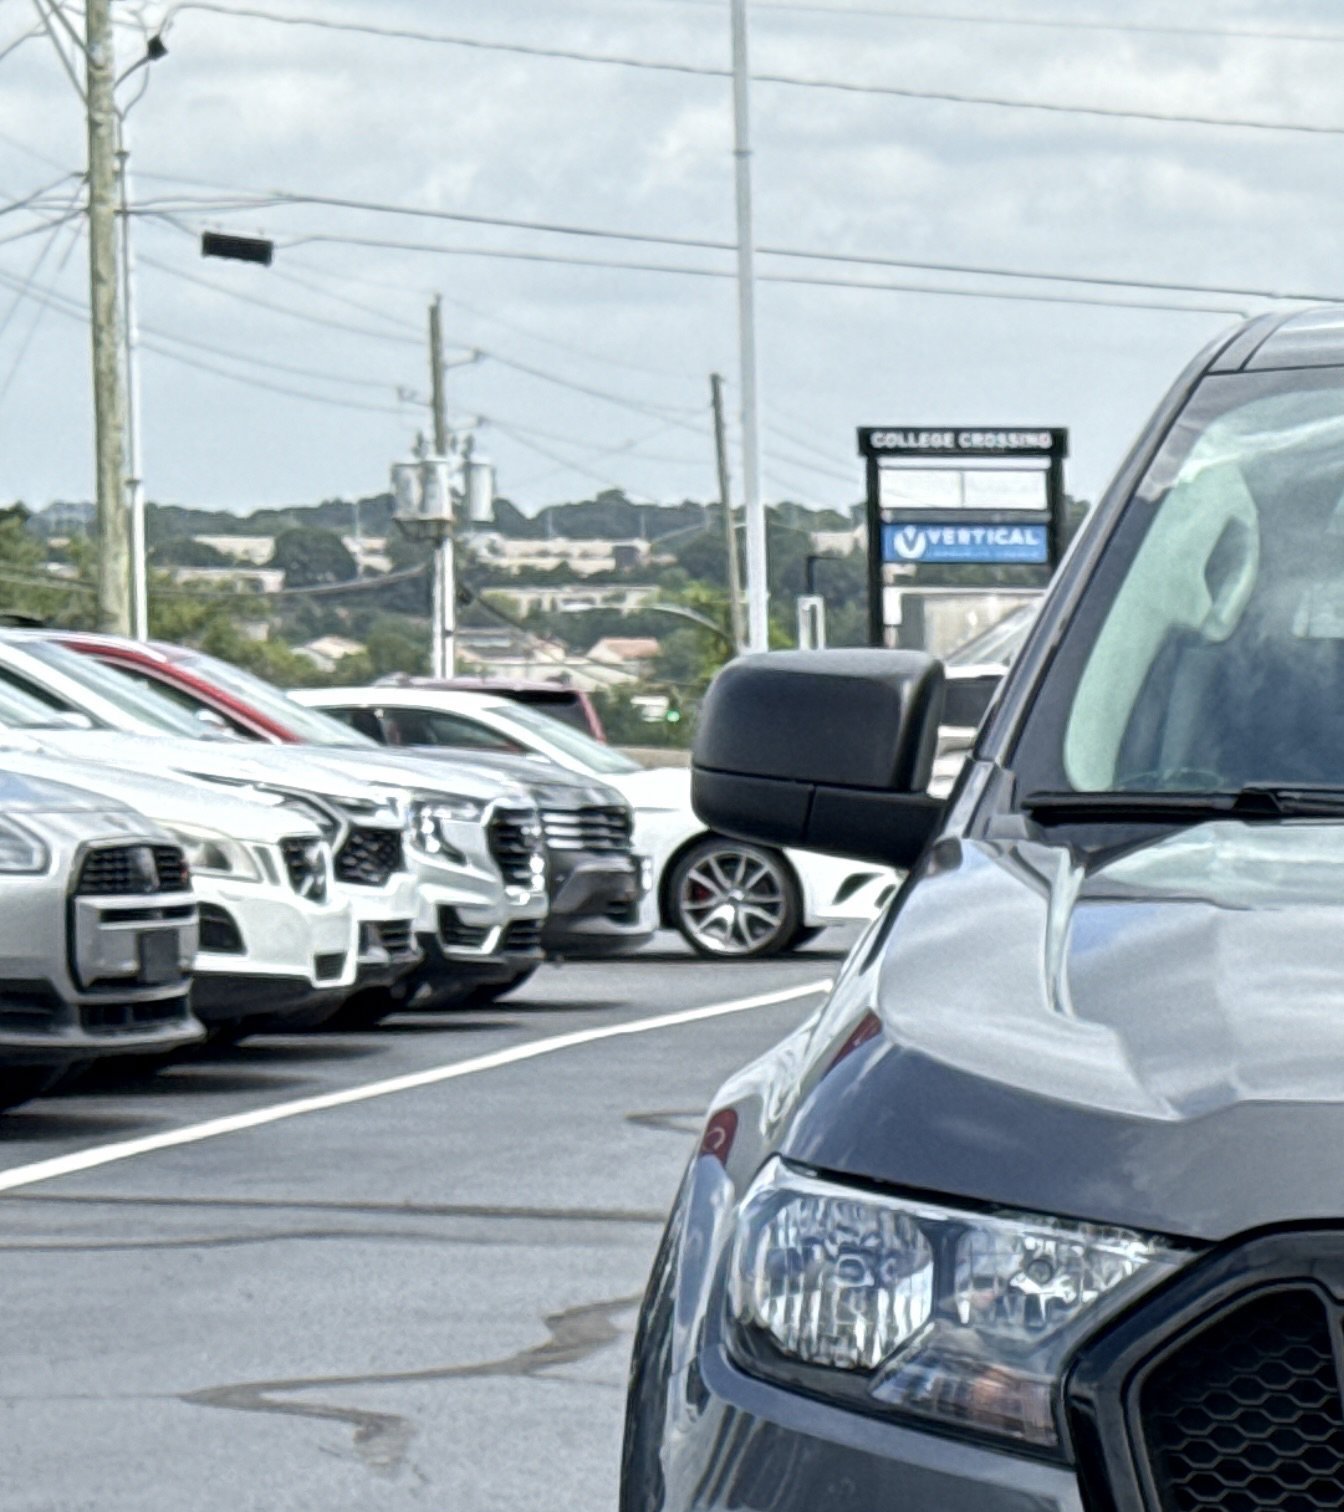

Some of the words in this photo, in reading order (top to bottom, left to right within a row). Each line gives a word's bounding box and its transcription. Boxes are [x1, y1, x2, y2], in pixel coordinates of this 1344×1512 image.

[870, 432, 954, 449] COLLEGE
[958, 432, 1052, 449] CROSSING
[927, 527, 1040, 546] VERTICAL
